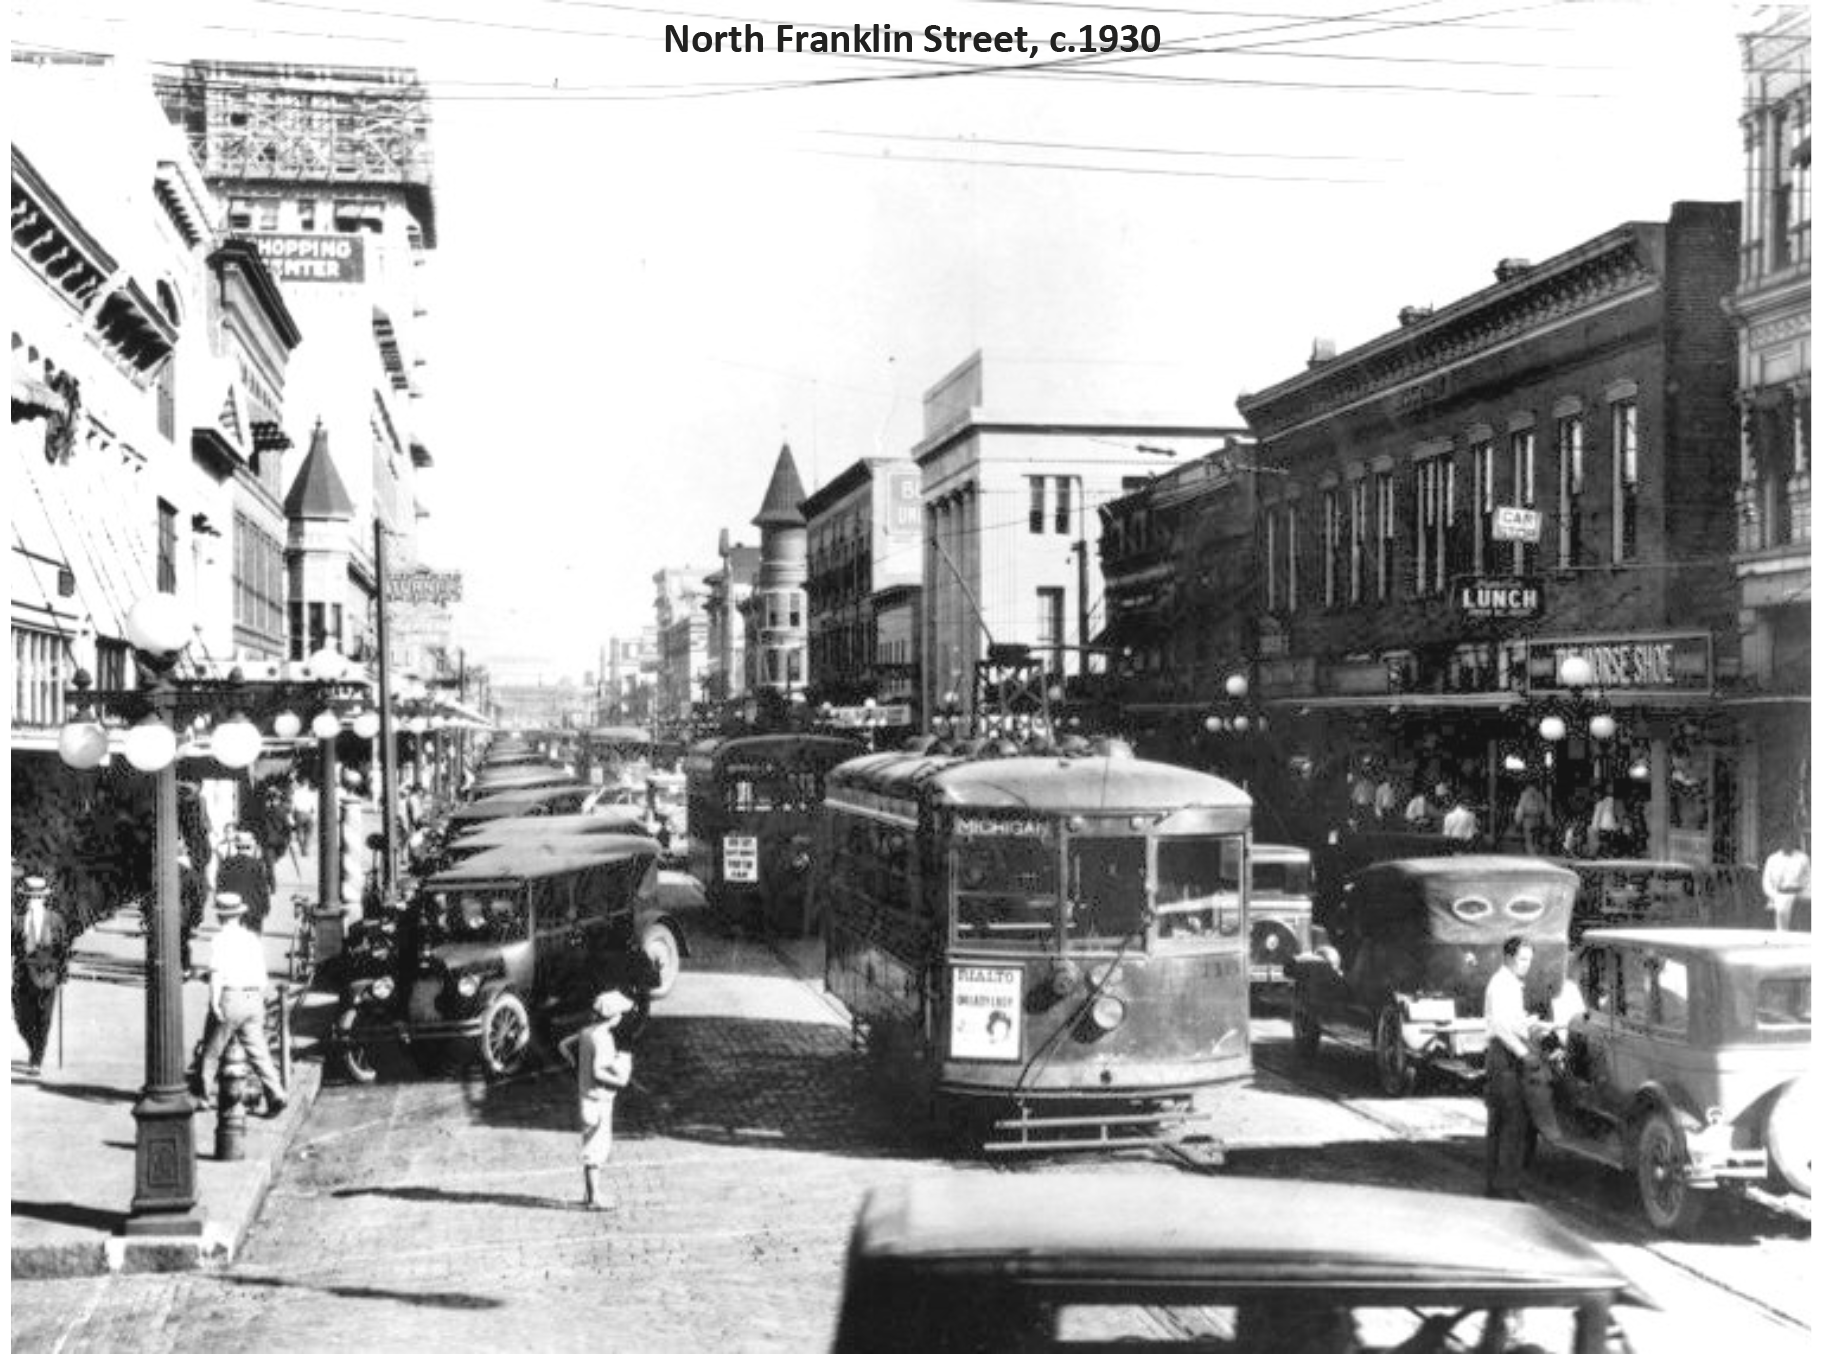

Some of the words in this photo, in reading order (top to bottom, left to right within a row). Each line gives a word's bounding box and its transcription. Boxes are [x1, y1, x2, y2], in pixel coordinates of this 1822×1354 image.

[247, 238, 352, 259] HOPPING
[263, 258, 341, 277] ENTER
[1503, 511, 1534, 527] CAR
[1462, 588, 1537, 608] LUNCH
[1633, 644, 1674, 683] SHOE
[955, 817, 1050, 838] MICHIGAN
[958, 968, 1014, 984] RIALTO
